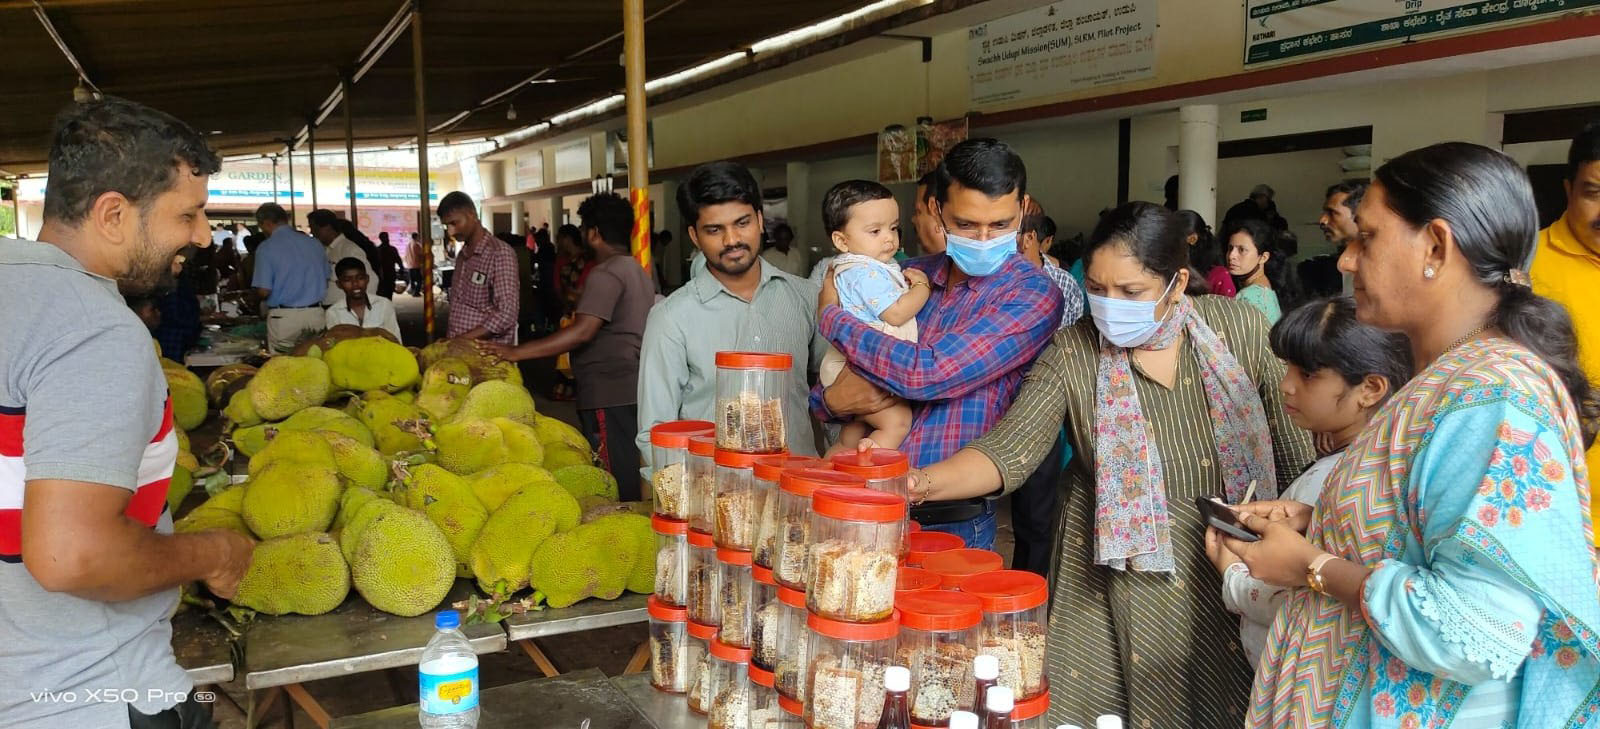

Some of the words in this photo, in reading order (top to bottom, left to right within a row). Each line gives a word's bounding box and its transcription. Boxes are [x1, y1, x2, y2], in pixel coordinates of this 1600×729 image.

[1436, 11, 1452, 25] ರೈತ
[1455, 8, 1478, 19] ಸೇವಾ
[977, 54, 1001, 67] Swachh
[1001, 49, 1020, 62] Udupi
[1097, 27, 1114, 40] Pilot
[1115, 21, 1142, 36] Project
[1280, 39, 1301, 53] ಪ್ರಧಾನ
[228, 171, 282, 181] GARDEN
